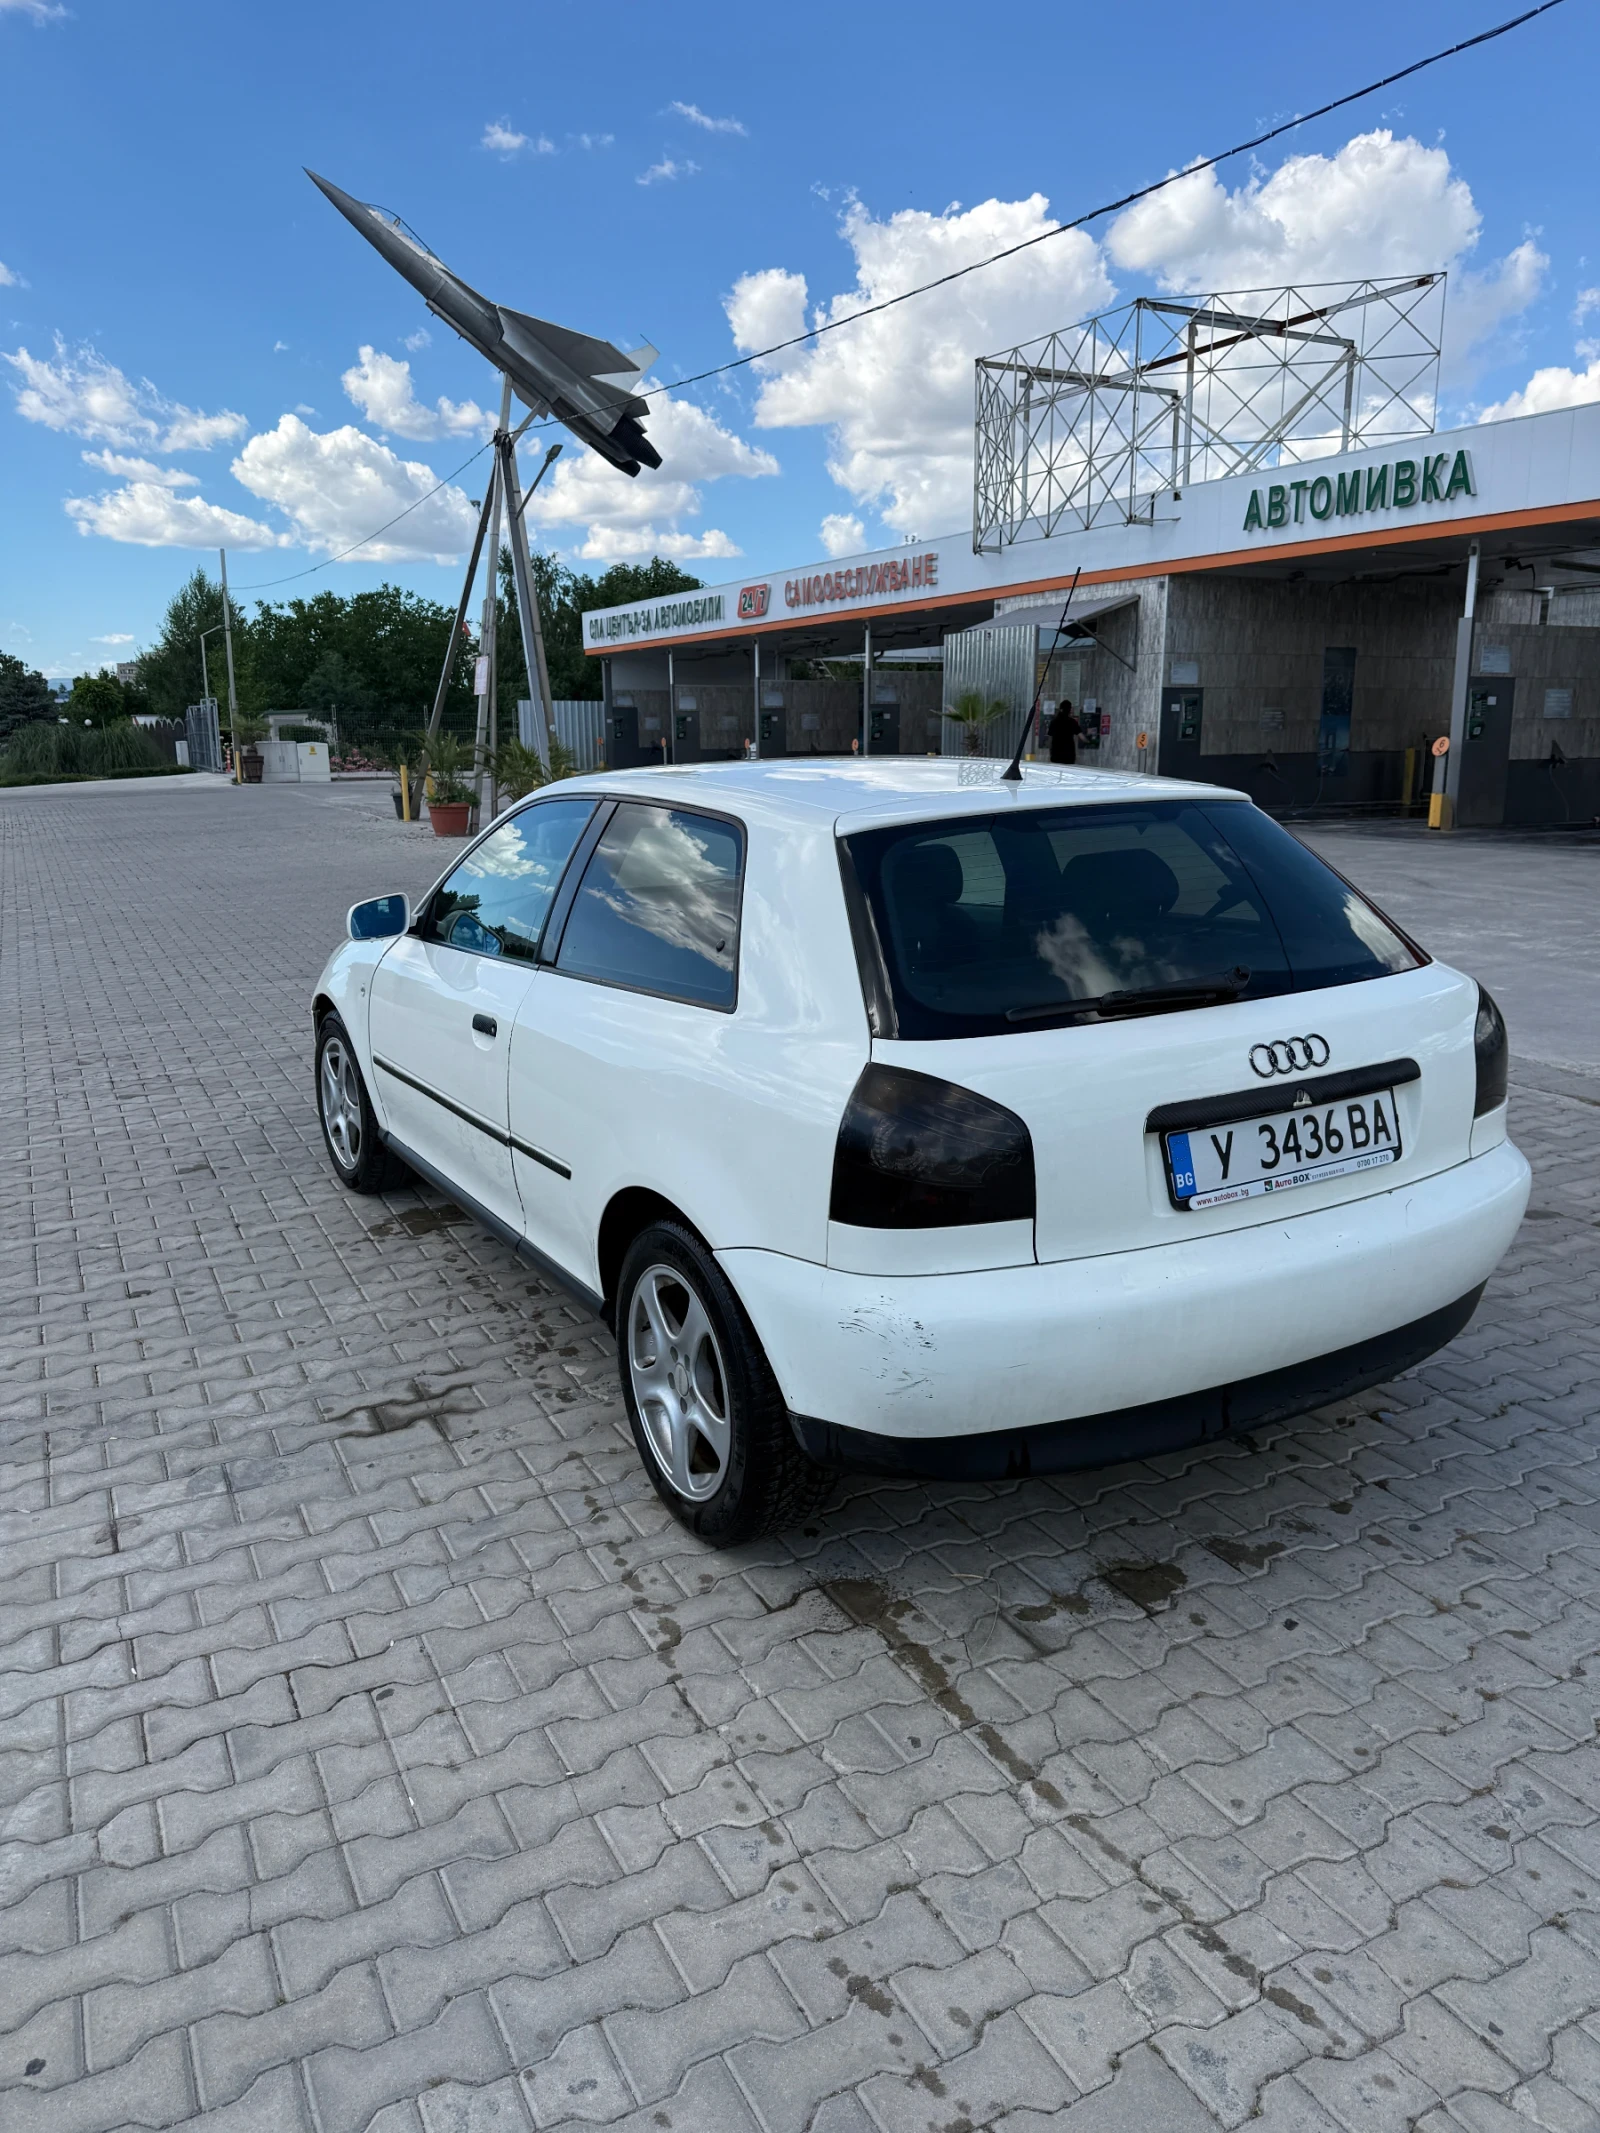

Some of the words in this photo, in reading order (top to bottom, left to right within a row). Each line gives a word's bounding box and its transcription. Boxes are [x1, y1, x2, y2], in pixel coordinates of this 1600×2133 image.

[1243, 450, 1477, 531] АВТОМИВКА
[742, 588, 766, 614] 24/7
[785, 553, 938, 607] САМООБСЛУЖВАНЕ
[589, 618, 605, 640] СПА
[606, 612, 641, 641] ЦЕНТЪР
[641, 609, 652, 632] ЗА
[654, 595, 725, 630] АВТОМОБИЛИ
[1258, 1109, 1345, 1170] 3436
[1176, 1172, 1193, 1188] BG
